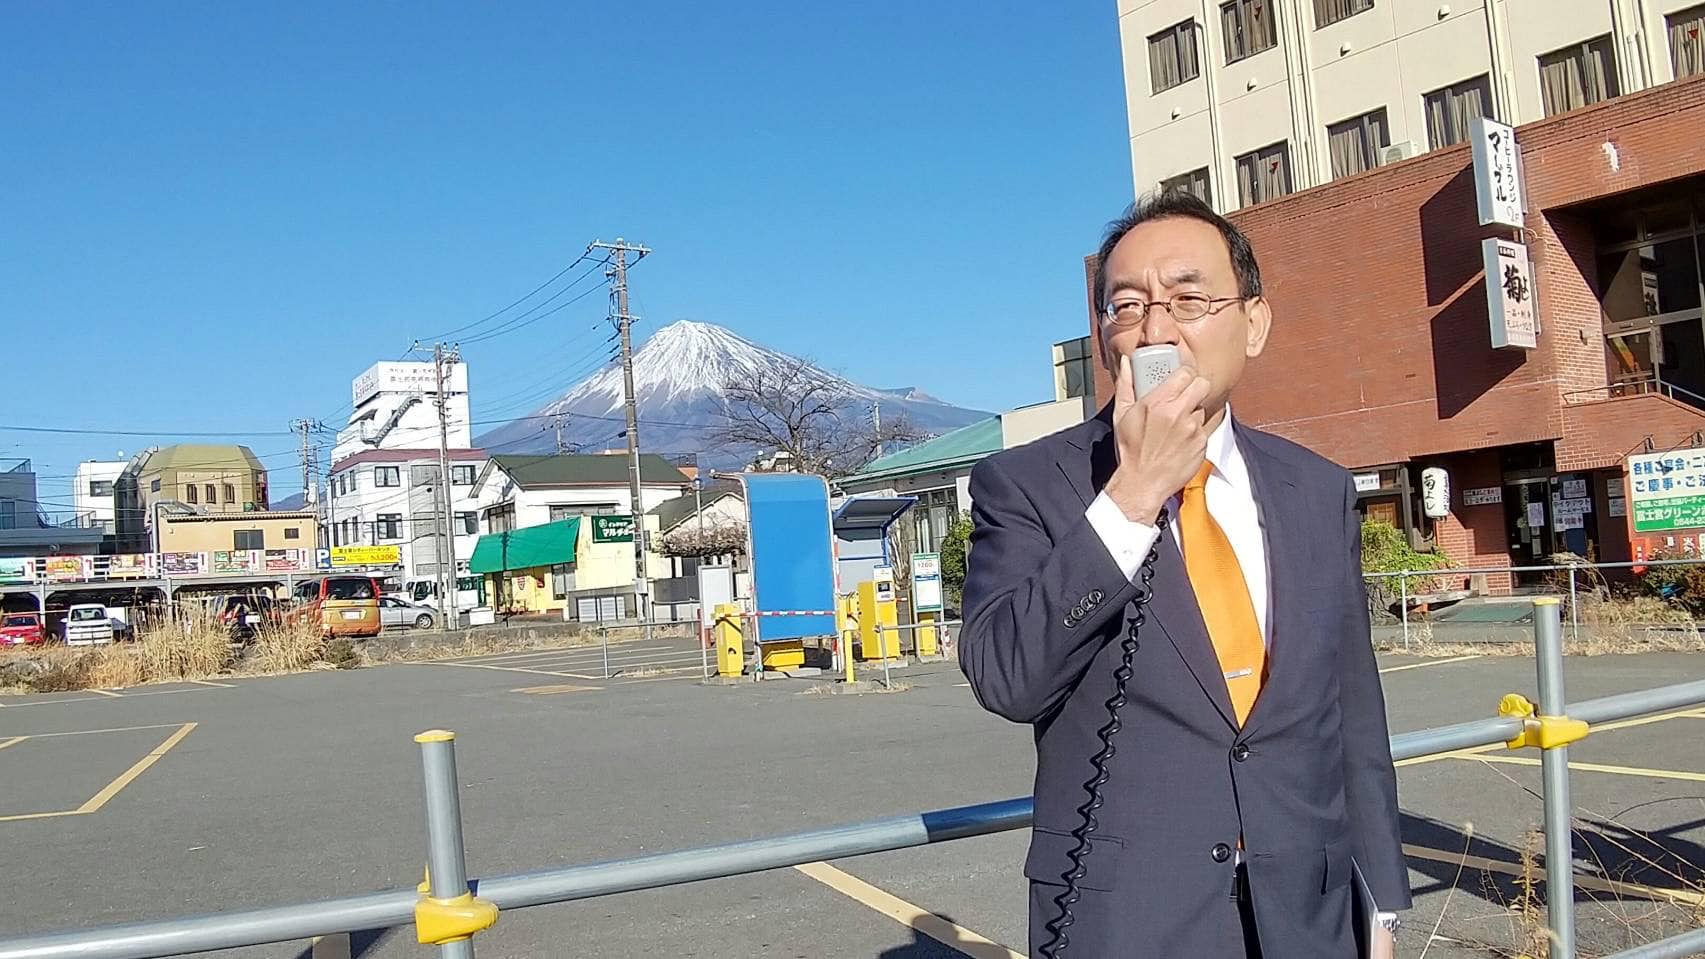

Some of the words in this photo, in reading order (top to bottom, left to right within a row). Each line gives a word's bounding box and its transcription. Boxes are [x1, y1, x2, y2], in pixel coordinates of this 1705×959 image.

[1488, 131, 1507, 202] マーブル
[1503, 129, 1516, 203] コーヒーラウンジ
[1633, 456, 1705, 475] 各種ご宴会・二
